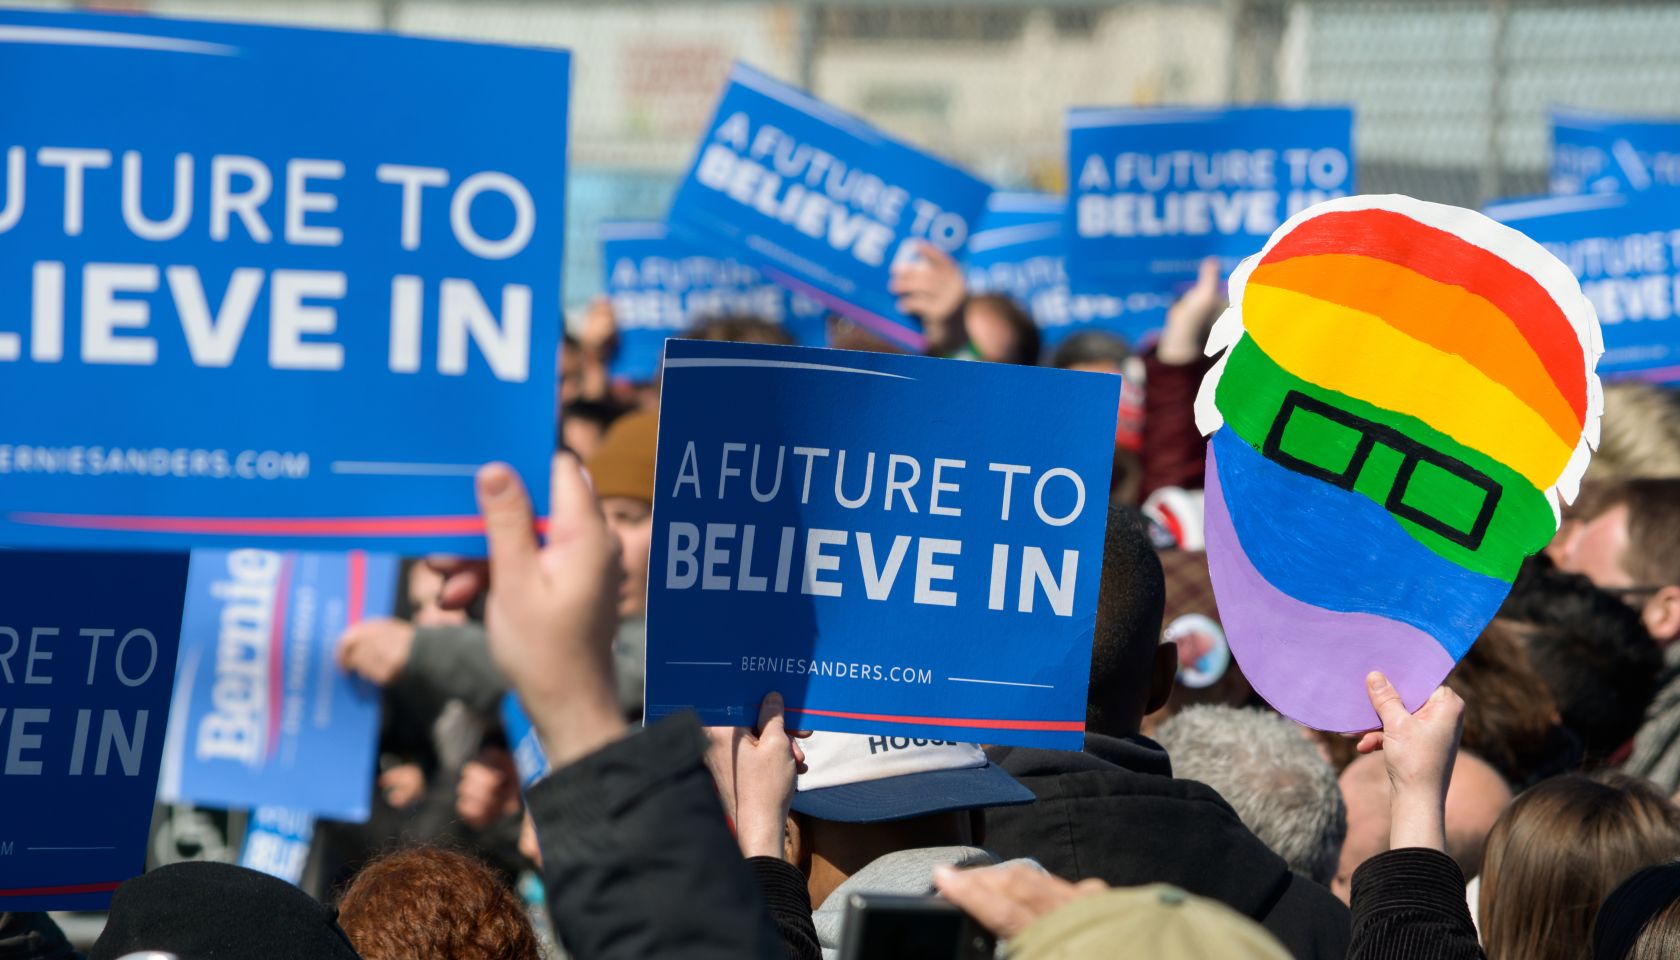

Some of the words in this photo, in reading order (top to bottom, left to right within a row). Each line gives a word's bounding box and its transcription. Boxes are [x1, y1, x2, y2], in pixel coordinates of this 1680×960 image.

[376, 164, 536, 260] TO
[697, 143, 896, 267] BELIEVE
[715, 111, 750, 151] A
[751, 125, 910, 226] FUTURE
[911, 198, 968, 251] TO
[1077, 190, 1281, 238] BELIEVE
[1079, 154, 1110, 190] A
[1115, 150, 1276, 190] FUTURE
[1284, 148, 1348, 189] TO
[388, 275, 532, 383] IN
[671, 440, 703, 499] A
[718, 442, 967, 517] FUTURE
[988, 462, 1086, 527] TO
[665, 521, 963, 607] BELIEVE
[988, 543, 1080, 617] IN
[79, 627, 159, 687] TO
[197, 549, 281, 766] Bernie
[740, 655, 934, 685] BERNIESANDERS.COM
[69, 708, 150, 777] IN
